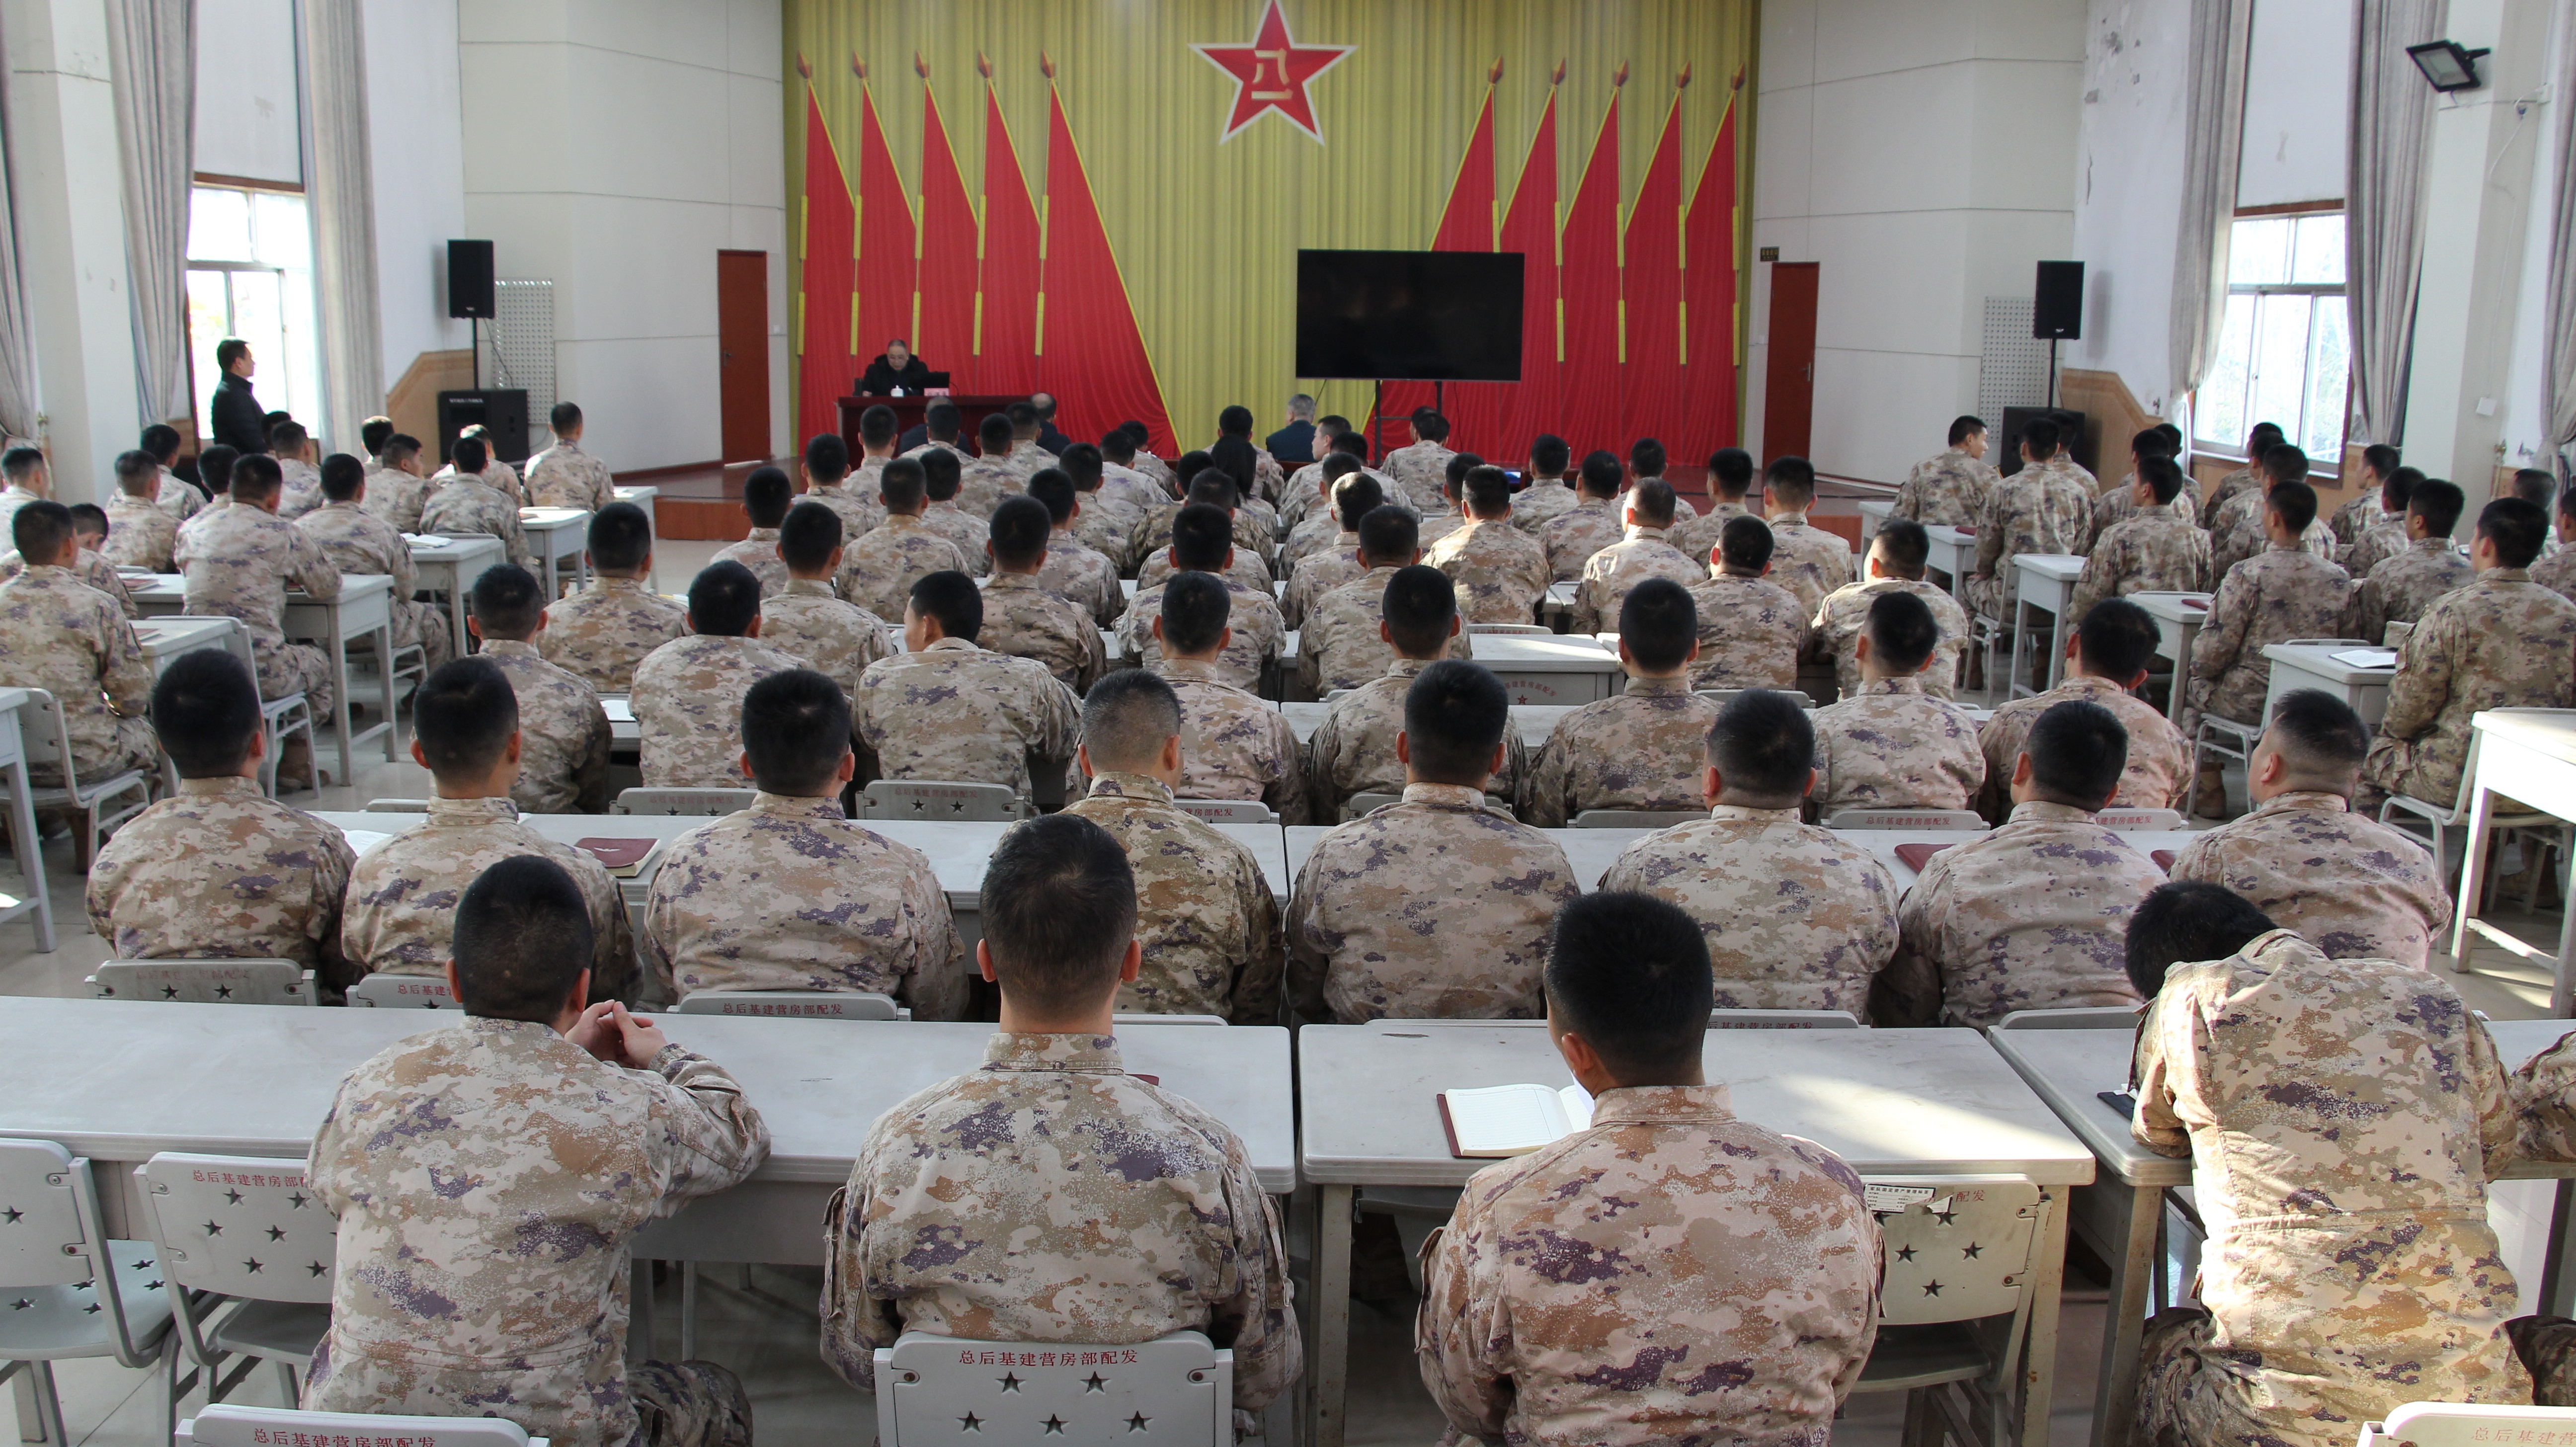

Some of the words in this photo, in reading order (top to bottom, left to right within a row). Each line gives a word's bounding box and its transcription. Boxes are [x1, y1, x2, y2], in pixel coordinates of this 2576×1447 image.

[1866, 816, 1950, 825] 总后基建营房部配发
[723, 1003, 843, 1015] 总后基建营房部配发
[959, 1349, 1138, 1367] 总后基建营房部配发
[2471, 1427, 2576, 1446] 总后基建营
